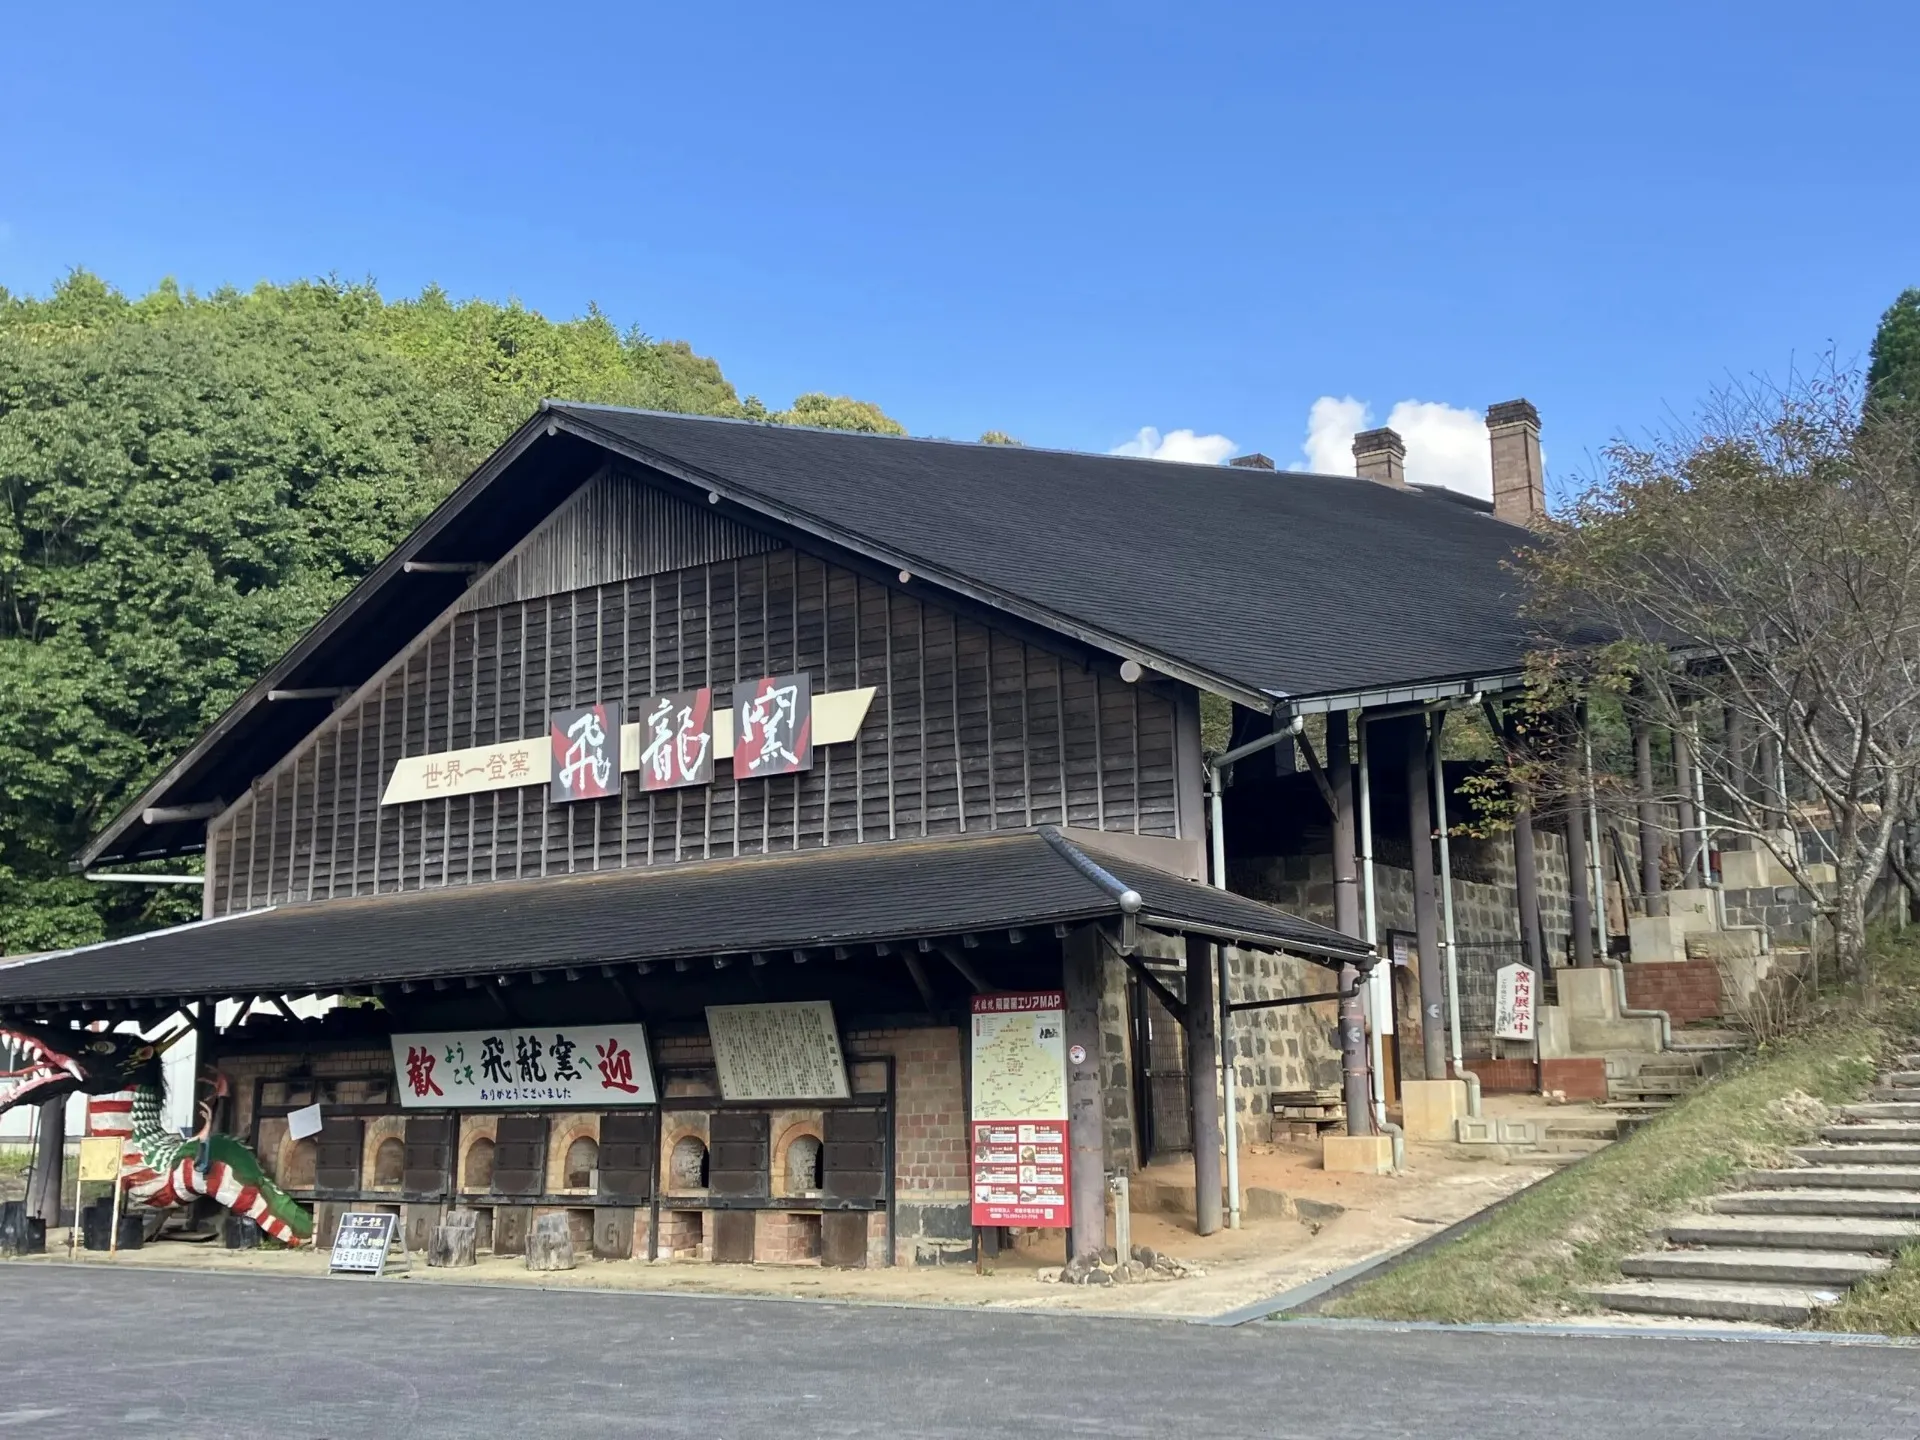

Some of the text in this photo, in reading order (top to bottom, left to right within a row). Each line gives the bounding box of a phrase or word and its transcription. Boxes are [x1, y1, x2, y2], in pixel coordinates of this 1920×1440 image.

[422, 750, 530, 790] 世界一登窯
[1514, 970, 1530, 1034] 窯内展示中
[481, 1088, 571, 1100] ありがとうございました
